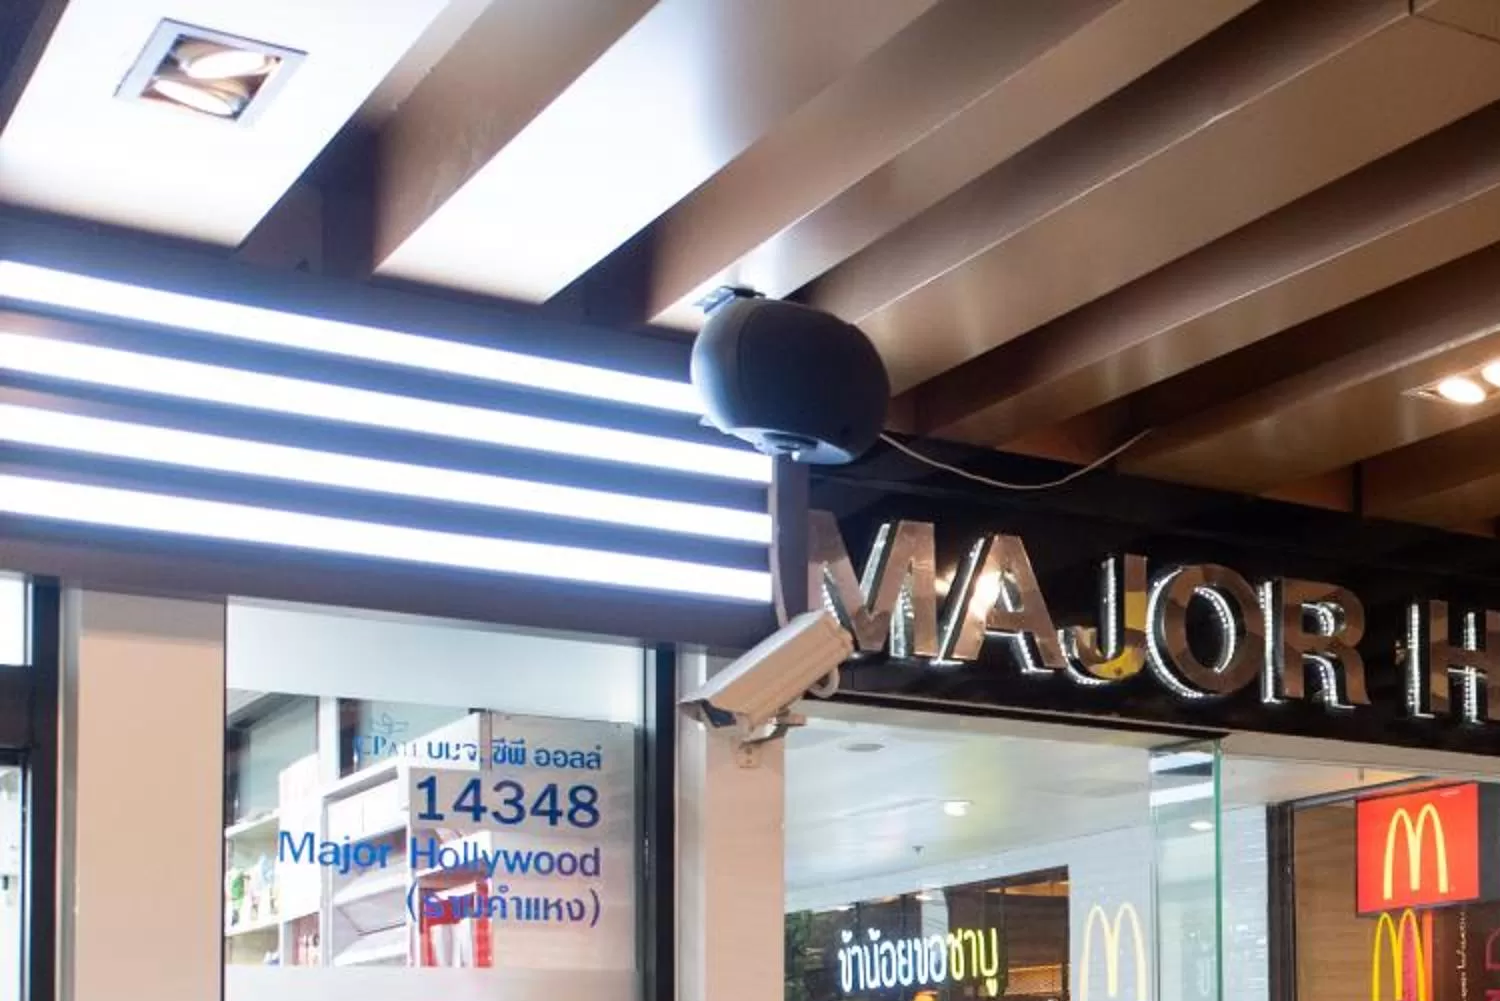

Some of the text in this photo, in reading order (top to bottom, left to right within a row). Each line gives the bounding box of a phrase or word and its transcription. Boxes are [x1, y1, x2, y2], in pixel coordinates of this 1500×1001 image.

[806, 509, 1372, 711] MAJOR
[533, 744, 602, 770] ออลล์
[415, 774, 601, 830] 14348
[278, 830, 601, 879] Major Hollywood
